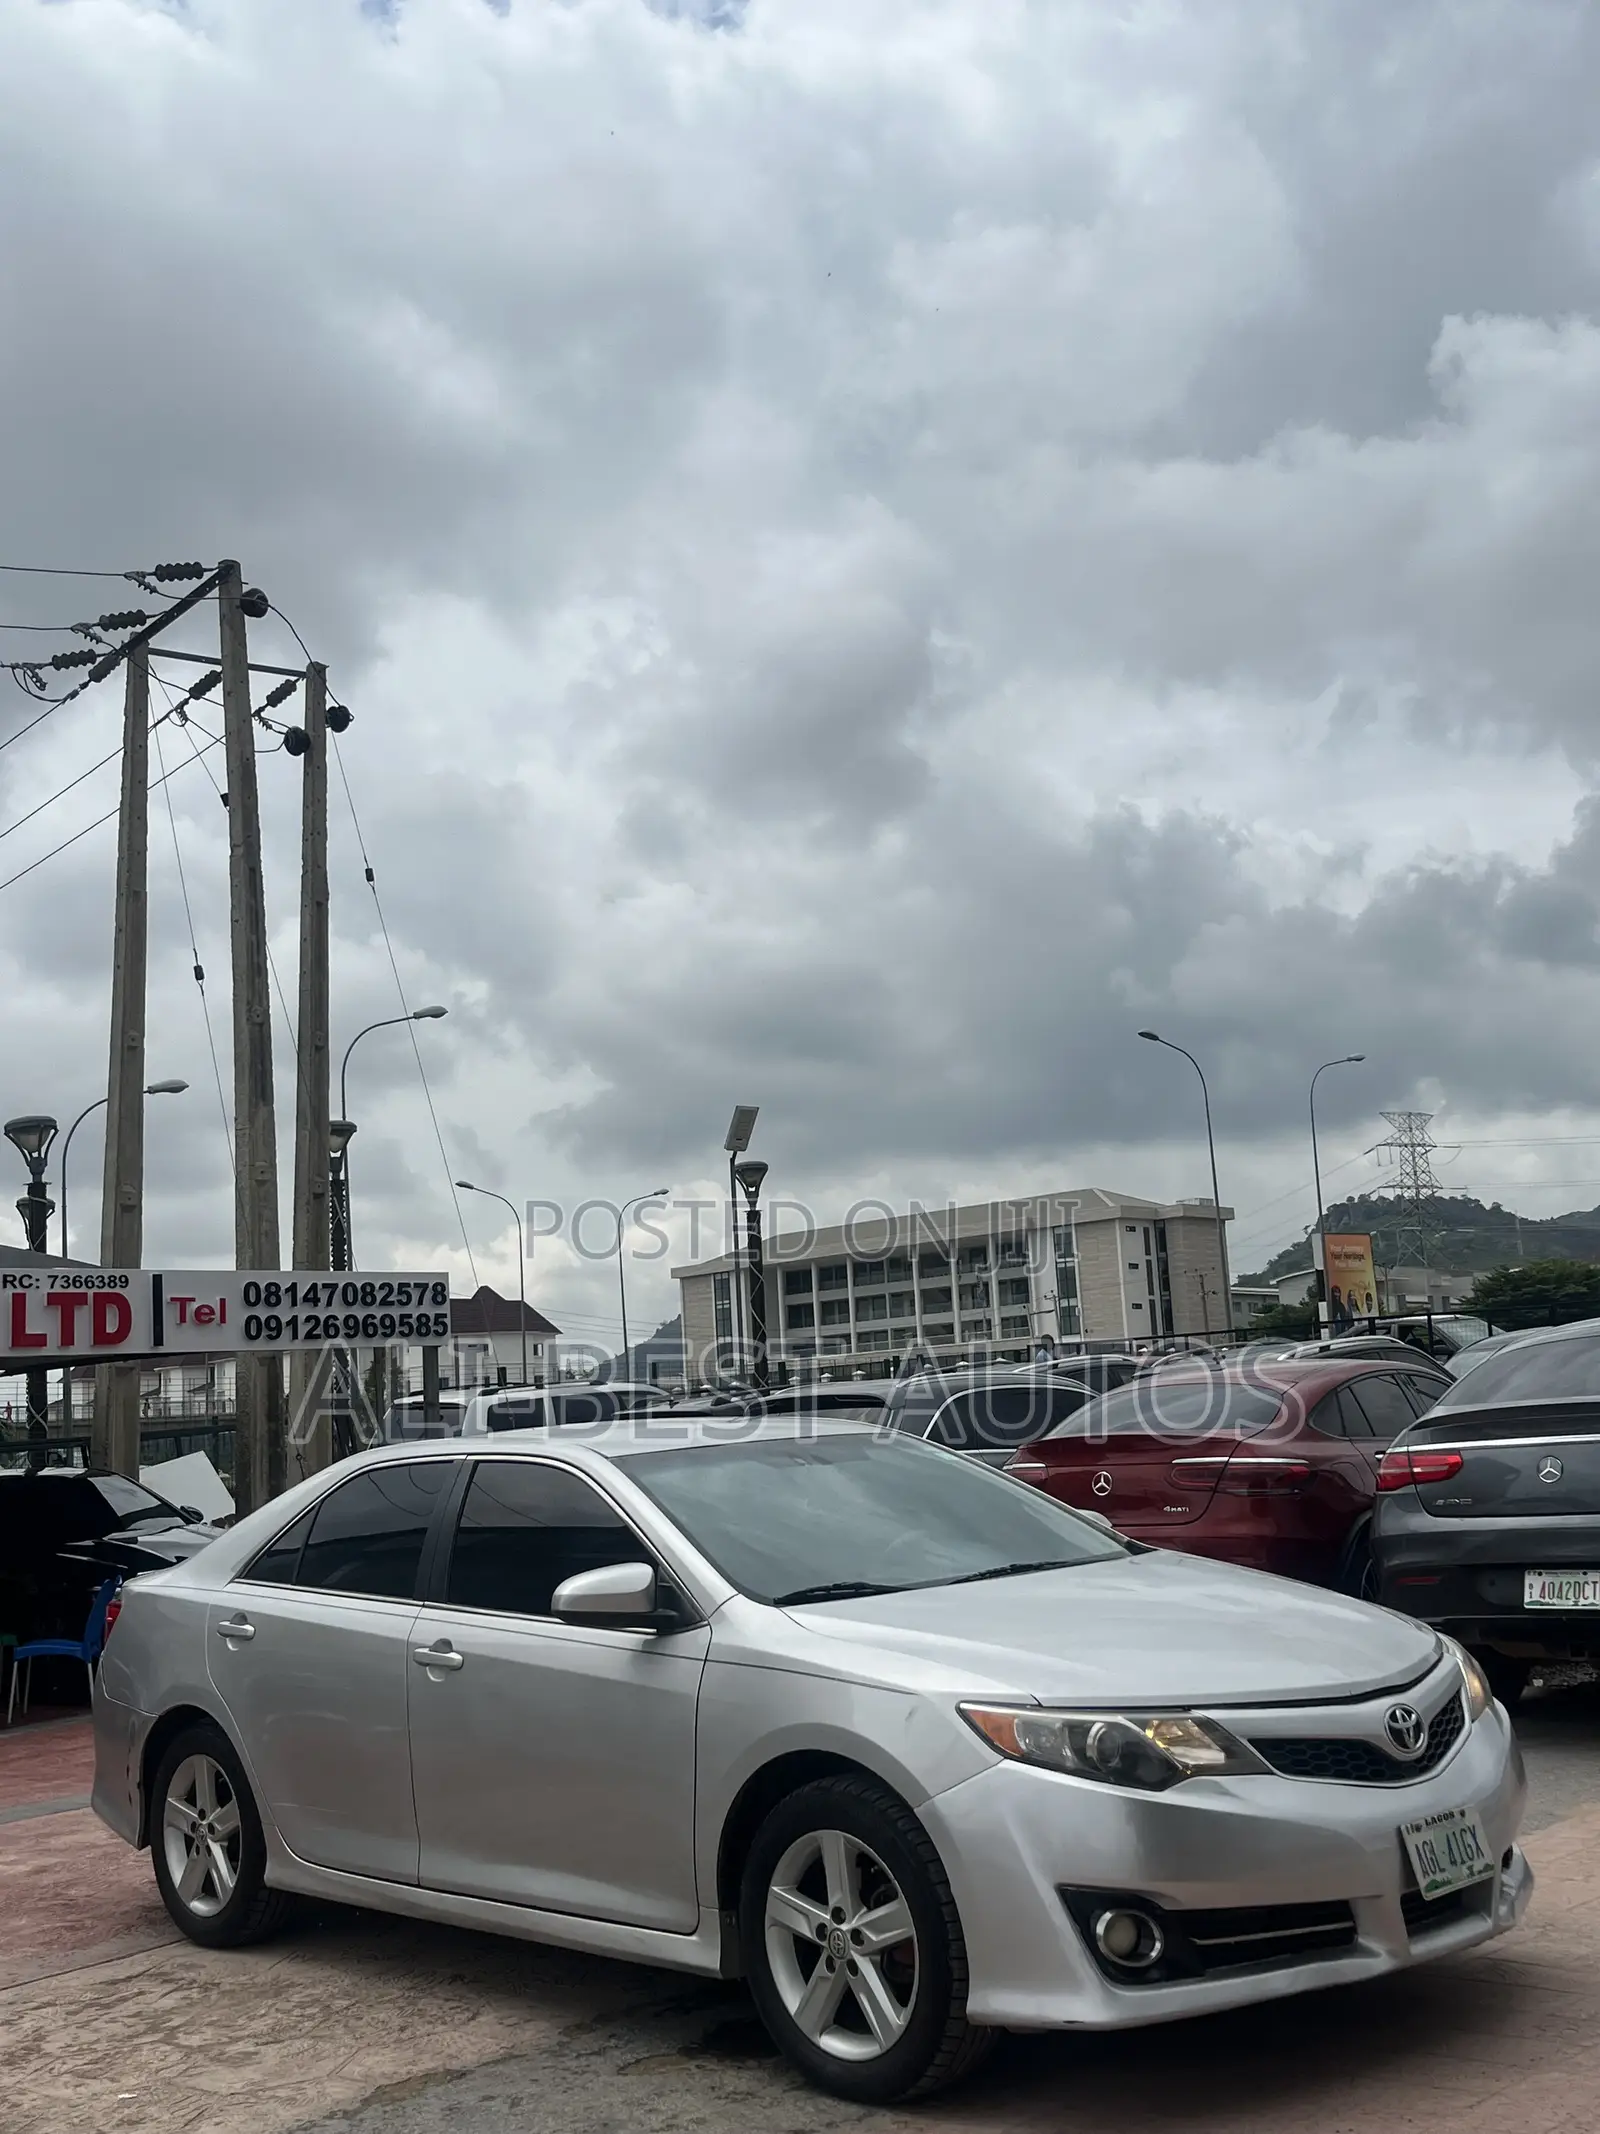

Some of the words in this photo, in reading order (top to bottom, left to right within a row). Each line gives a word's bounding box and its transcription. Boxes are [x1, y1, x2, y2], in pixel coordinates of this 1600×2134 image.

[2, 1274, 40, 1290] RC:
[47, 1274, 130, 1290] 7366389
[243, 1280, 447, 1308] 08147082578
[10, 1291, 133, 1348] LTD
[169, 1296, 227, 1325] Tel
[243, 1312, 448, 1341] 09126969585
[1424, 1810, 1456, 1827] LAGOS
